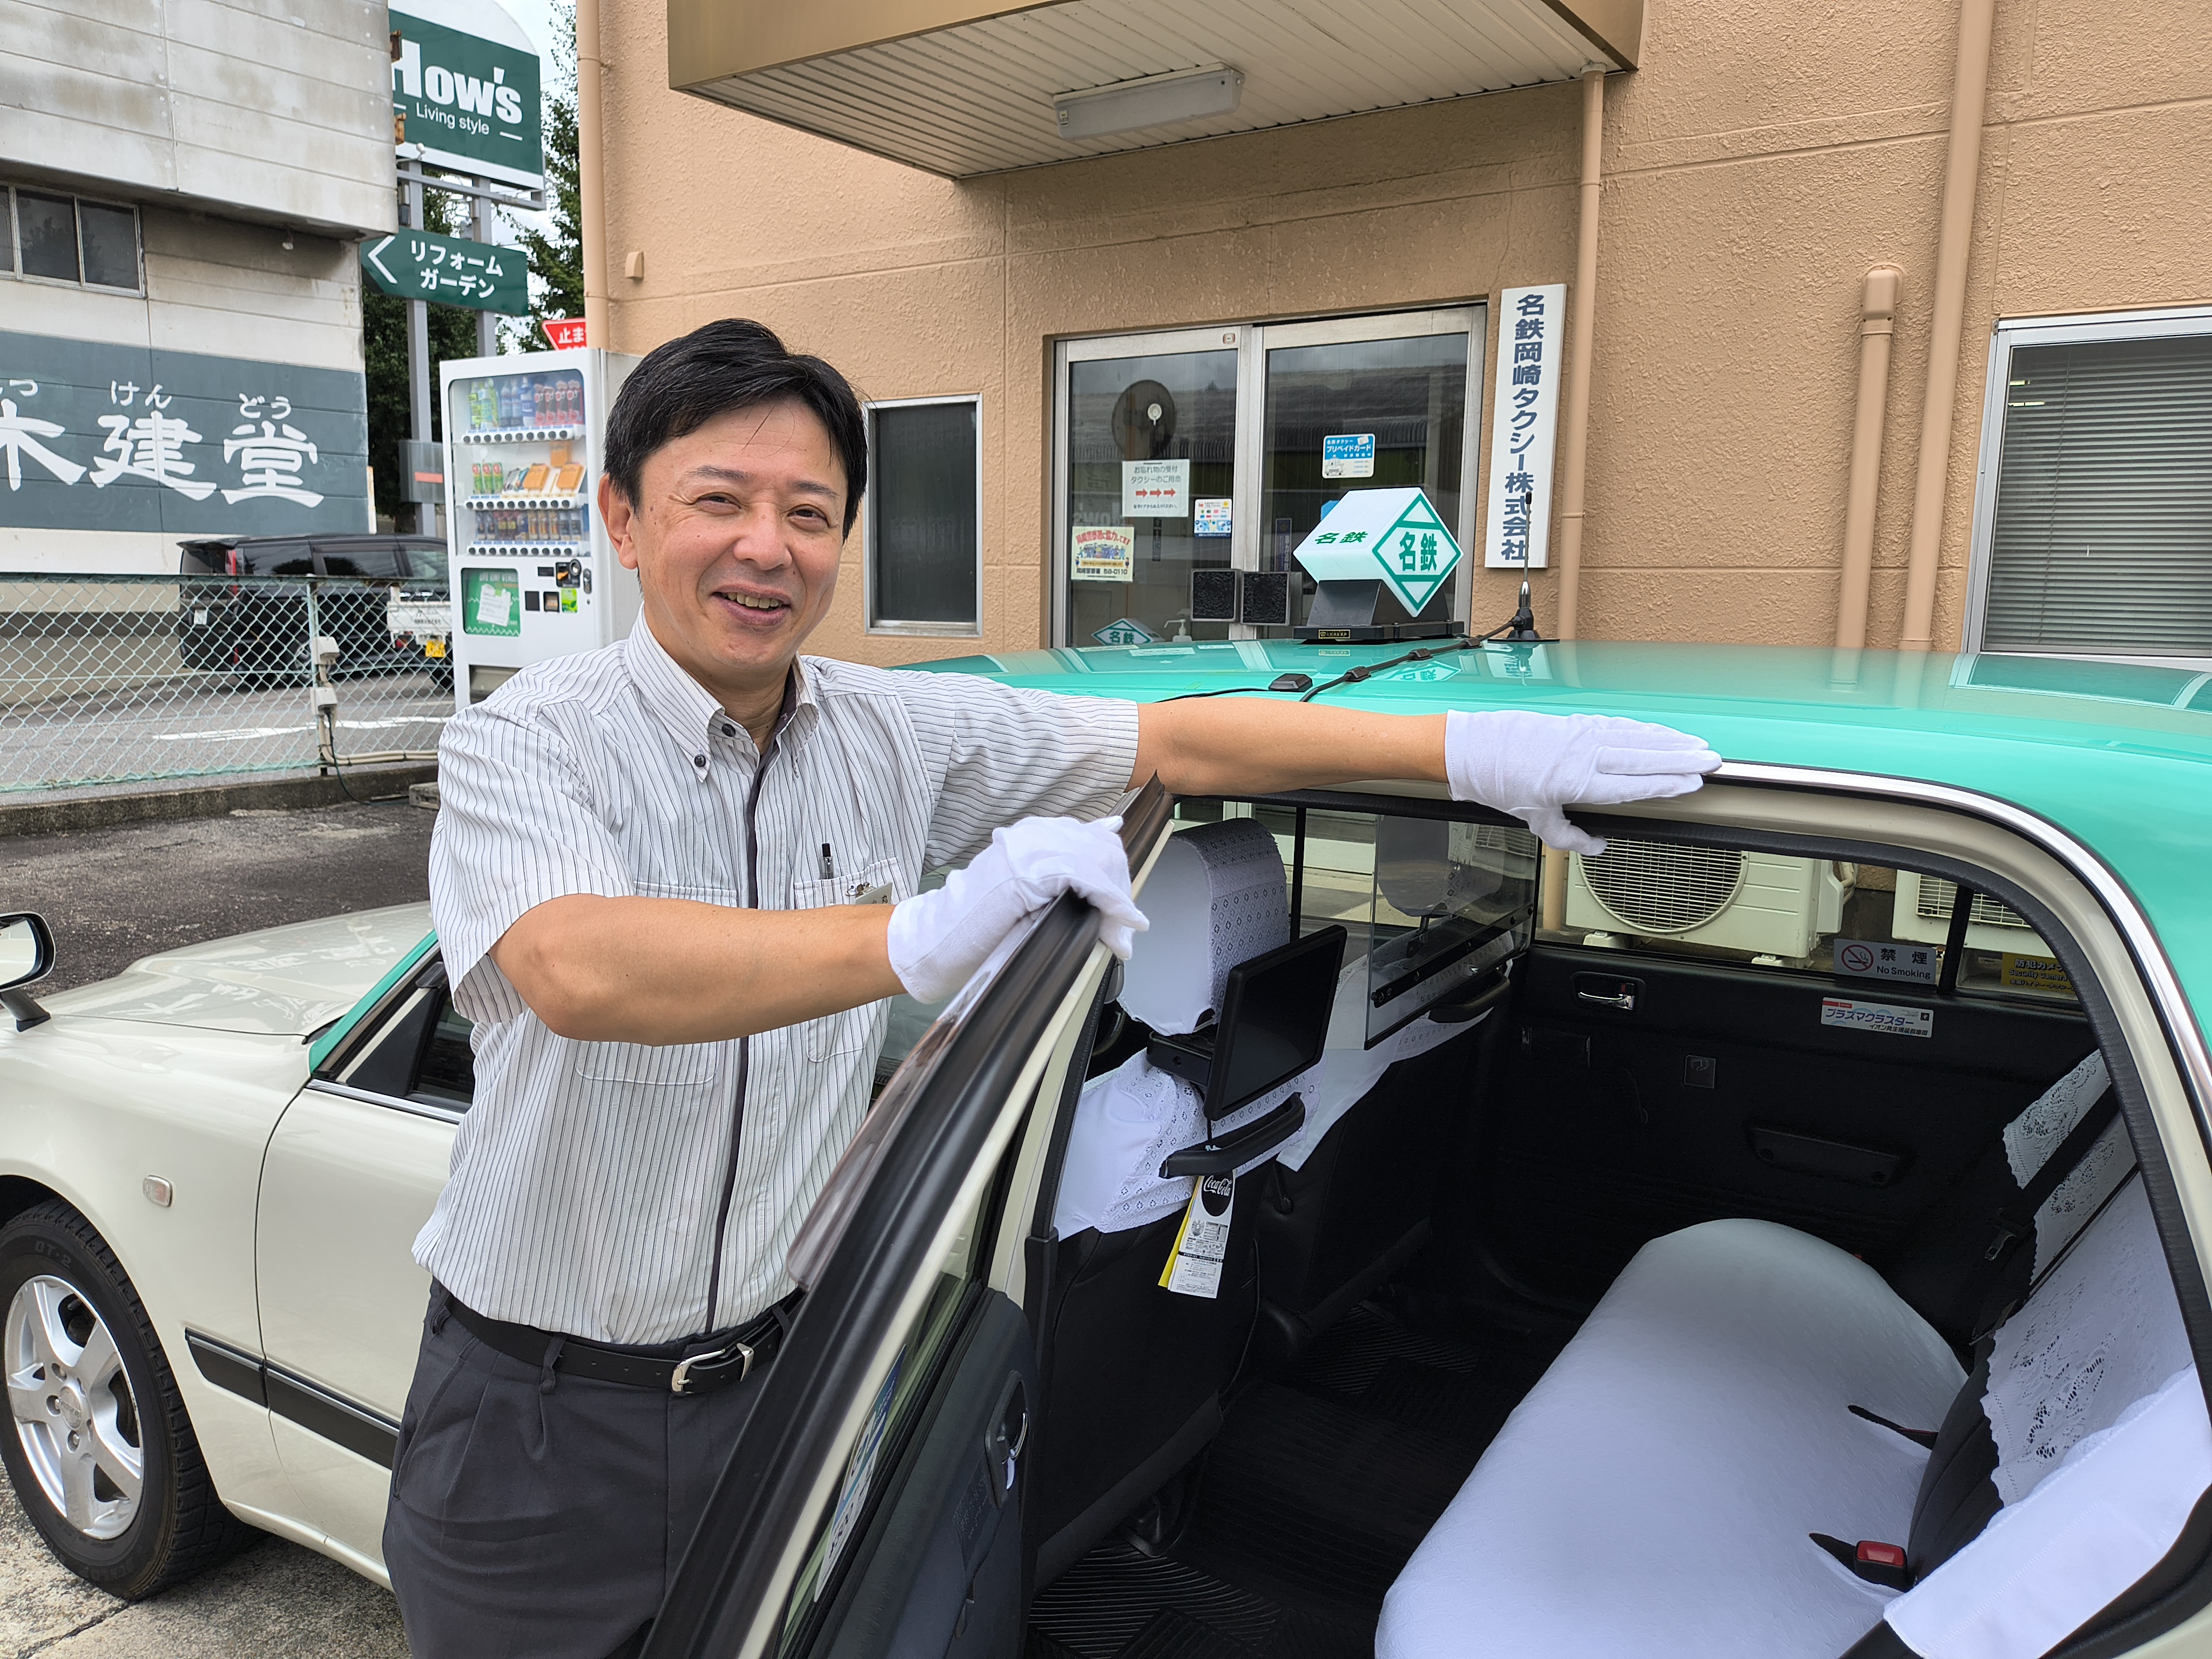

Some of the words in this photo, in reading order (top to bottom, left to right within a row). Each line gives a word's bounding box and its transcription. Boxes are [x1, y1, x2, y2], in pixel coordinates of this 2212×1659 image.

[392, 38, 523, 125] How's
[416, 102, 456, 130] Living
[459, 116, 490, 135] style
[410, 239, 504, 278] リフォーム
[420, 267, 496, 299] ガーデン
[558, 326, 586, 344] 止ま
[1501, 294, 1545, 561] 名鉄岡崎タクシー株式会社
[1314, 531, 1368, 544] 名鉄
[1399, 531, 1438, 572] 名鉄
[1109, 631, 1135, 644] 名鉄
[1880, 947, 1928, 965] 禁煙
[1876, 966, 1890, 974] No
[1891, 967, 1931, 980] Smoking
[2009, 969, 2039, 980] Security
